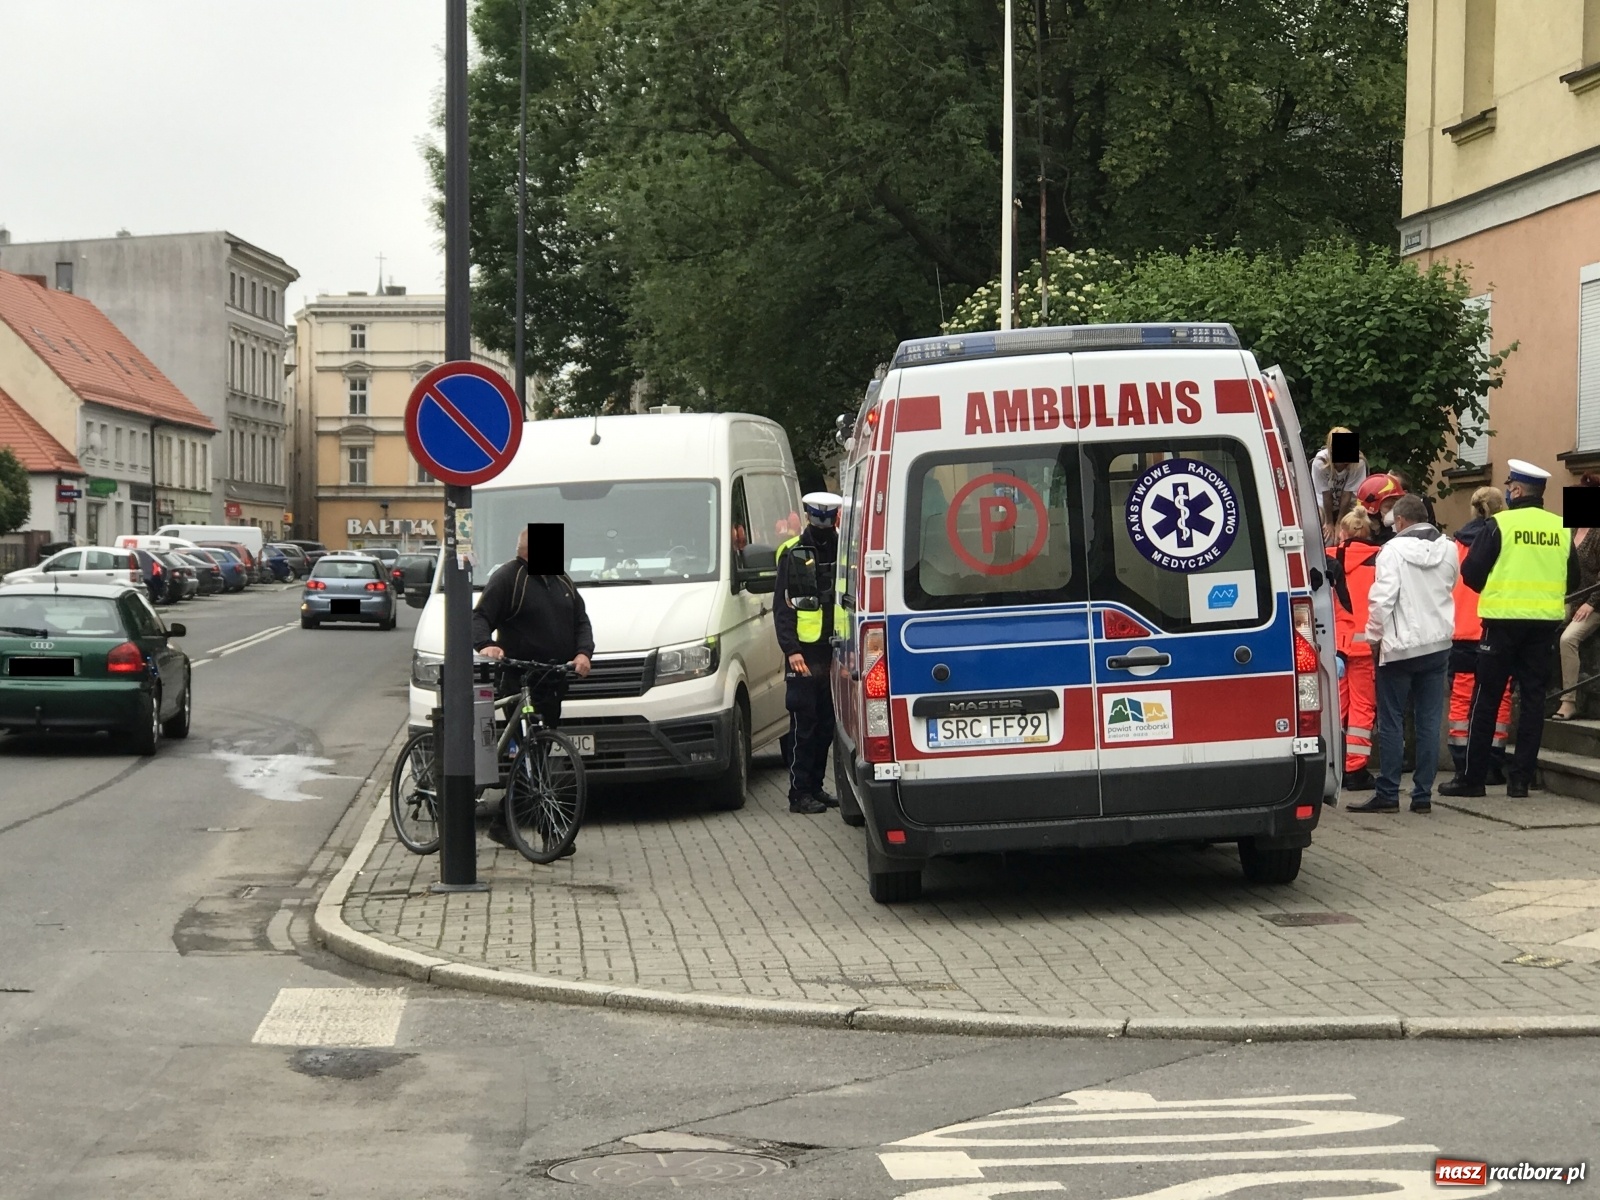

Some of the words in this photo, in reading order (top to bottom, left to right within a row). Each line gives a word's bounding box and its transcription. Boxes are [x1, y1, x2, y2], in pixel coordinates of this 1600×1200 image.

[965, 380, 1202, 435] AMBULANS
[1128, 464, 1171, 542] PAŃSTWOWE
[1188, 462, 1236, 535] RATOWNICTWO
[979, 496, 1017, 554] P
[1514, 530, 1560, 546] POLICJA
[1151, 546, 1221, 569] MEDYCZNE
[949, 699, 1023, 712] MASTER
[941, 718, 982, 740] SRC
[989, 715, 1041, 737] FF99
[1107, 725, 1132, 734] powiat
